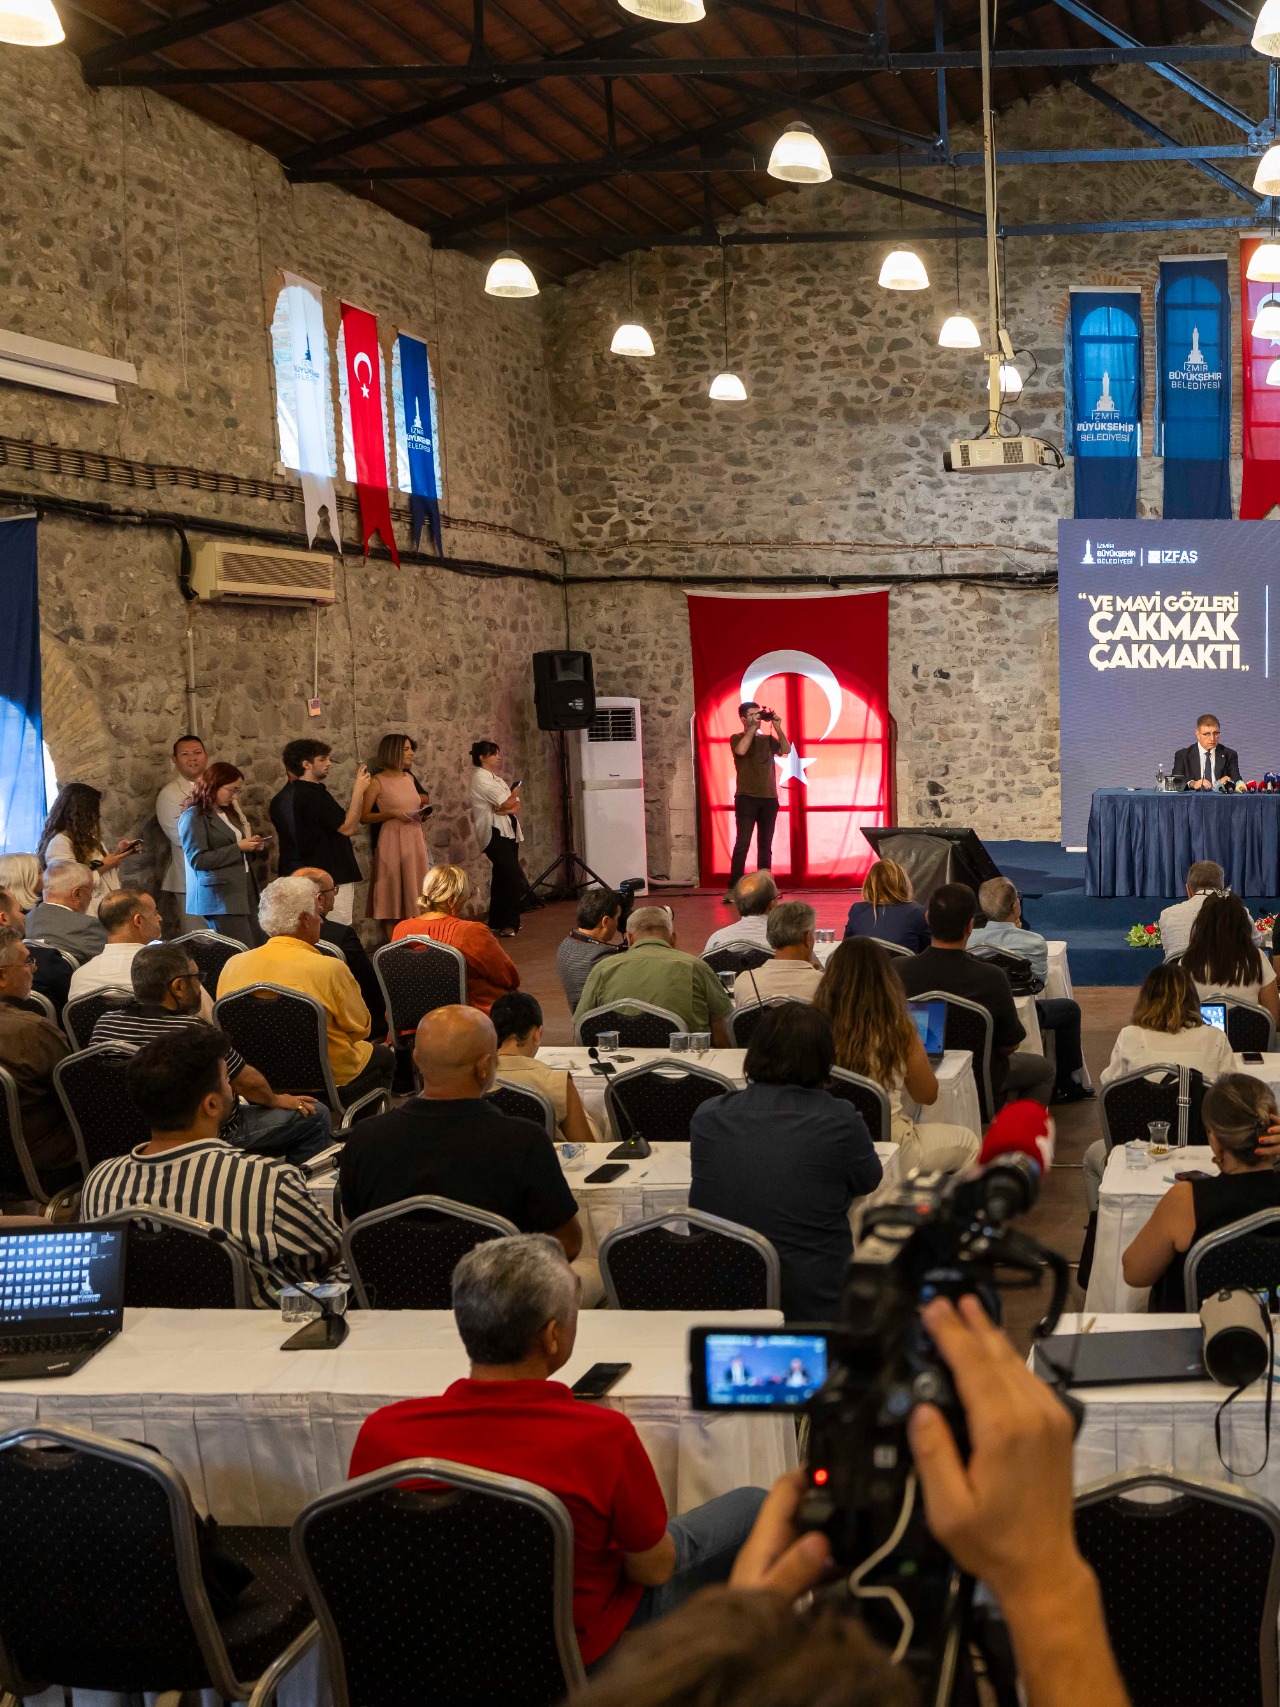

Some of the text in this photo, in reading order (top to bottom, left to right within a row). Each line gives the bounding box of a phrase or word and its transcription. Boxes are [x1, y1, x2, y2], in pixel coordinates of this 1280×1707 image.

[1116, 591, 1161, 612] MAVİ
[1163, 591, 1239, 612] GÖZLERİ
[1088, 611, 1240, 643] ÇAKMAK
